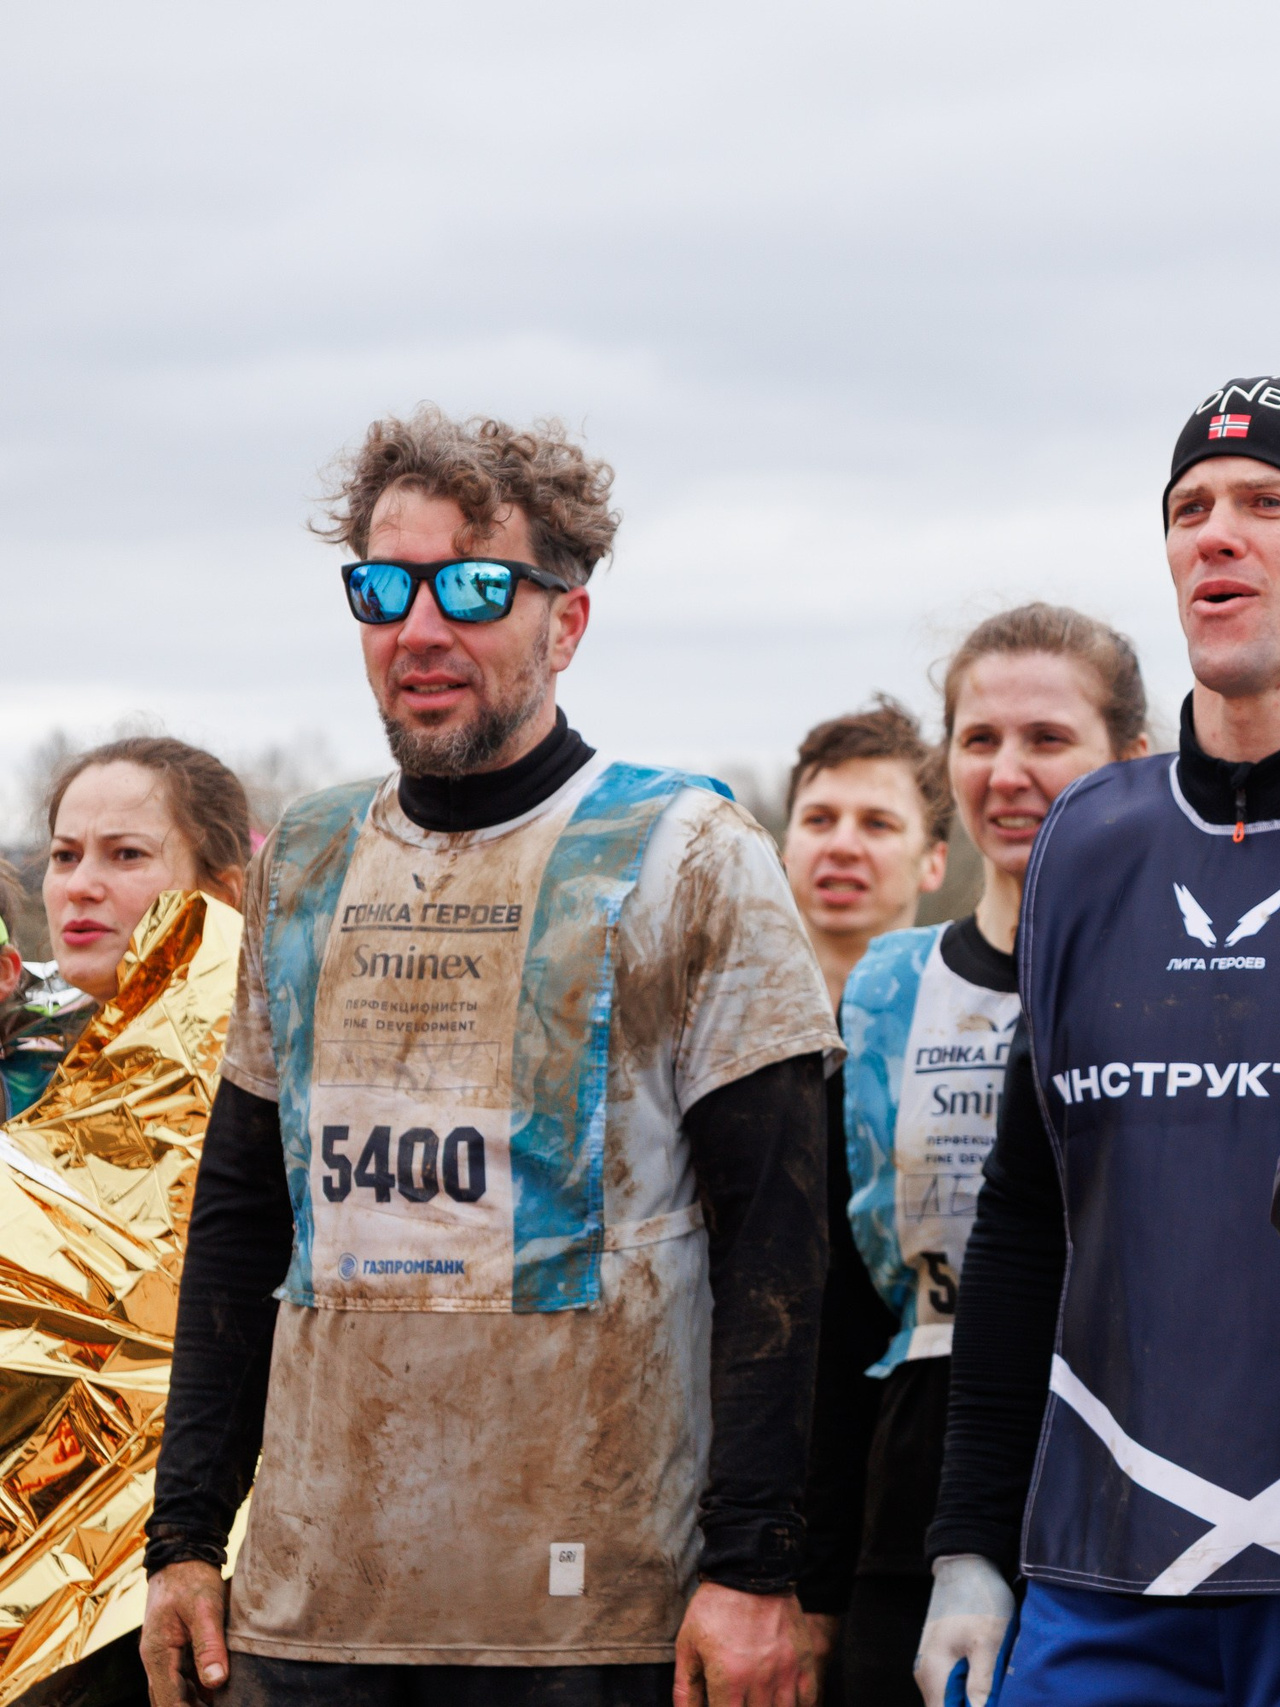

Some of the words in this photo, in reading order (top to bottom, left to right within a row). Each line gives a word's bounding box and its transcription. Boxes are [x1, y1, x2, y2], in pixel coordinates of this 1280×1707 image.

[343, 903, 411, 924] ГОНКА
[421, 903, 522, 925] ГЕРОЕВ
[351, 944, 483, 979] Sminex
[1166, 958, 1206, 971] ЛИГА
[1209, 956, 1266, 971] ГЕРОЕВ
[345, 999, 478, 1014] ПЕРФЕКЦИОНИСТЫ
[343, 1018, 368, 1029] FINE
[376, 1019, 476, 1032] DEVELOPMENT
[916, 1045, 986, 1066] ГОНКА
[322, 1125, 486, 1203] 5400
[925, 1154, 953, 1164] FINE
[363, 1259, 465, 1274] ГАЗПРОМБАНК
[920, 1252, 956, 1314] 5
